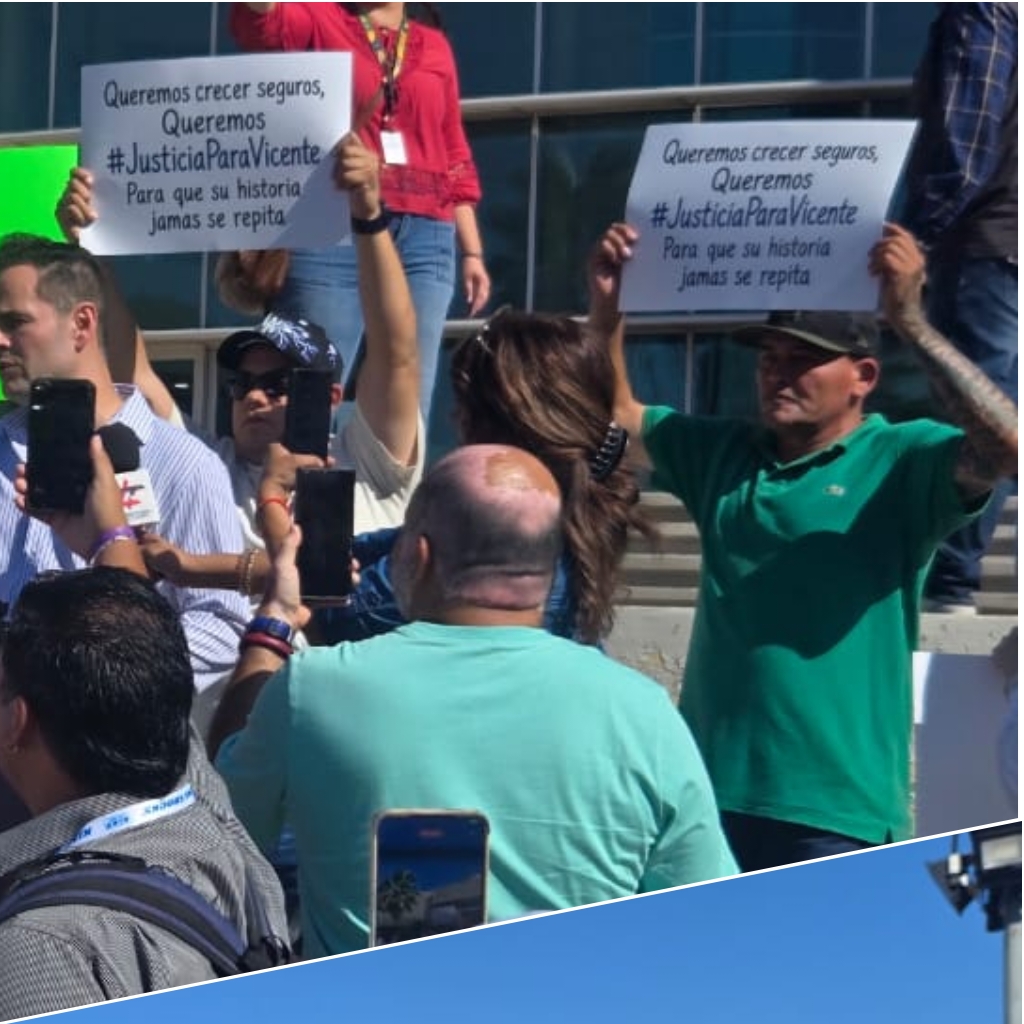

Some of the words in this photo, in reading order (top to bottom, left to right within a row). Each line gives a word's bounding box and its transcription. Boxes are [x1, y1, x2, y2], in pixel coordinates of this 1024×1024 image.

[104, 80, 190, 109] Queremos
[195, 81, 252, 103] crecer
[257, 77, 325, 103] seguros,
[162, 110, 266, 136] Queremos
[107, 136, 321, 176] #JusticiaParaVicente
[662, 139, 748, 165] Queremos
[751, 143, 805, 162] crecer
[812, 142, 879, 167] seguros,
[127, 182, 164, 205] Para
[173, 184, 203, 208] que
[211, 184, 229, 200] su
[237, 176, 301, 200] historia
[711, 167, 814, 194] Queremos
[148, 206, 202, 236] jamas
[207, 211, 225, 229] se
[233, 206, 286, 233] repita
[651, 194, 859, 230] #JusticiaParaVicente
[663, 237, 698, 261] Para
[707, 242, 736, 266] que
[743, 243, 761, 258] su
[767, 236, 831, 257] historia
[677, 267, 728, 292] jamas
[734, 270, 752, 286] se
[759, 267, 811, 291] repita
